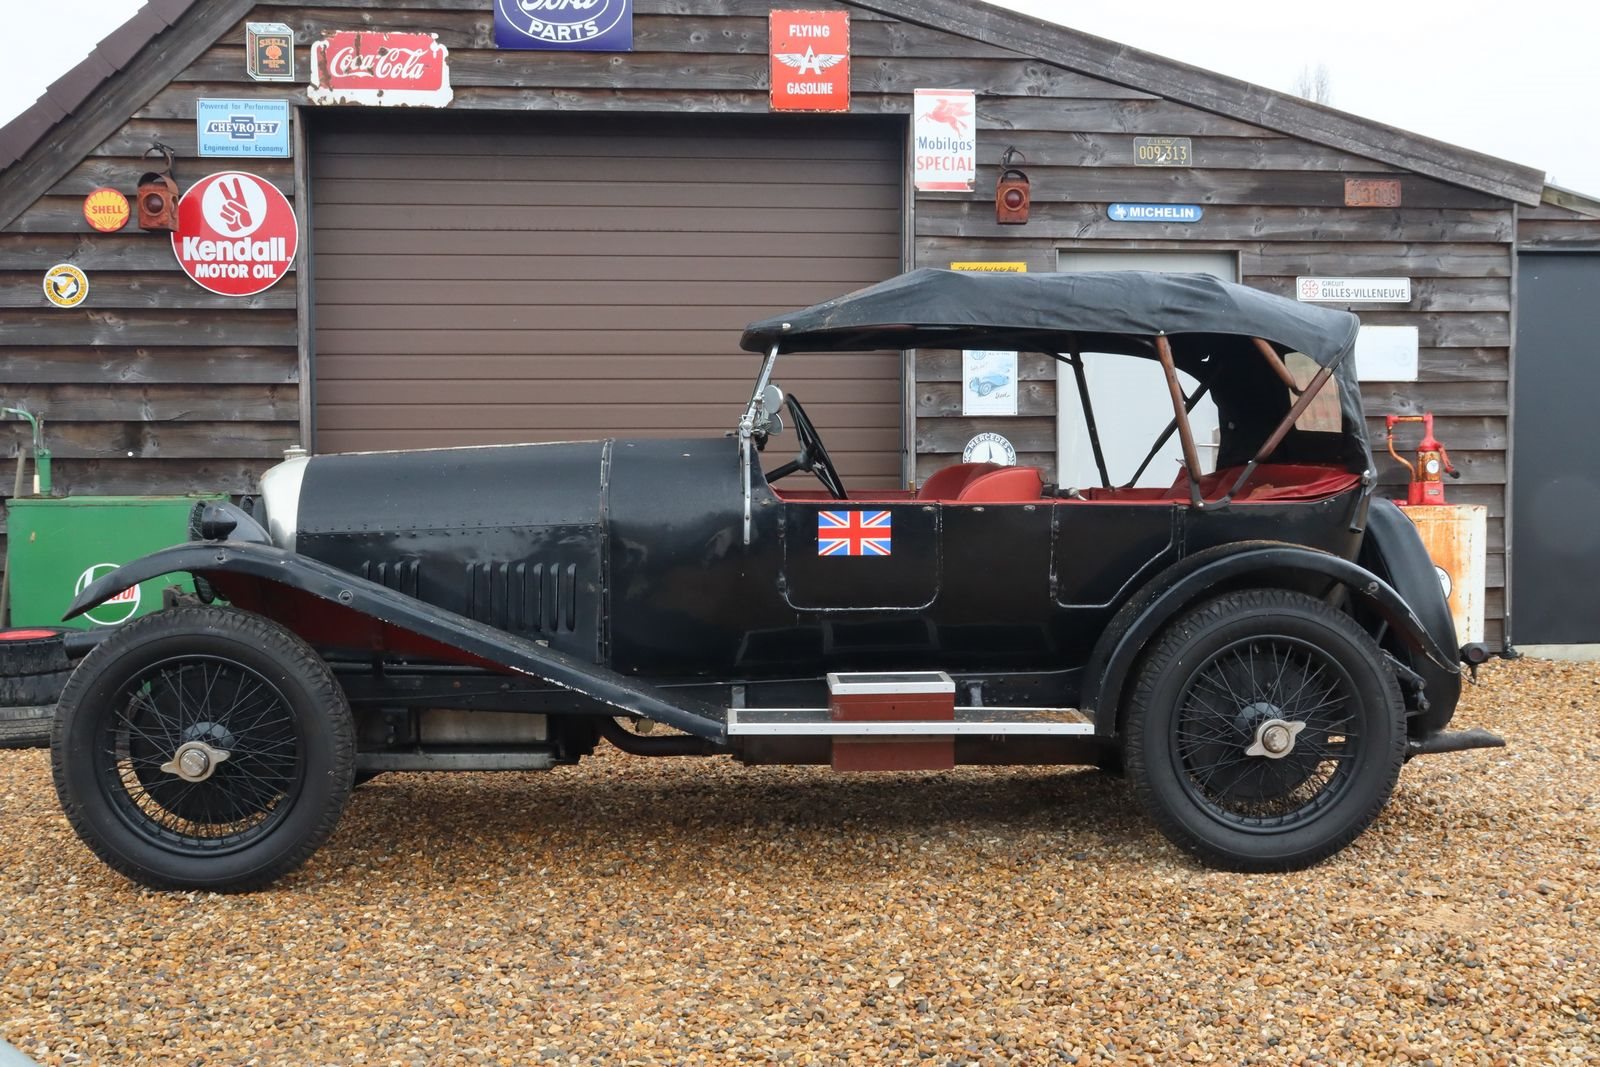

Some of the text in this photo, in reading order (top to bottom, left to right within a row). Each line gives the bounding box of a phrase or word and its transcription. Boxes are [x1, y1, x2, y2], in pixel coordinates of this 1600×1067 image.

[528, 20, 599, 40] PARTS
[789, 24, 830, 37] FLYING
[259, 38, 288, 48] SHELL
[330, 46, 428, 79] Coca-Cola
[786, 82, 833, 95] GASOLINE
[201, 102, 228, 110] Powered
[244, 103, 285, 111] Performance
[211, 123, 274, 132] CHEVROLET
[204, 144, 239, 152] Engineered
[254, 145, 283, 153] Economy
[916, 156, 974, 171] SPECIAL
[92, 205, 123, 215] SHELL
[1130, 207, 1194, 218] MICHELIN
[183, 236, 286, 262] Kendall
[195, 263, 277, 278] MOTOR OIL
[1322, 288, 1406, 298] GILLES-VILLENEUVE
[969, 433, 1009, 450] MERCEDES
